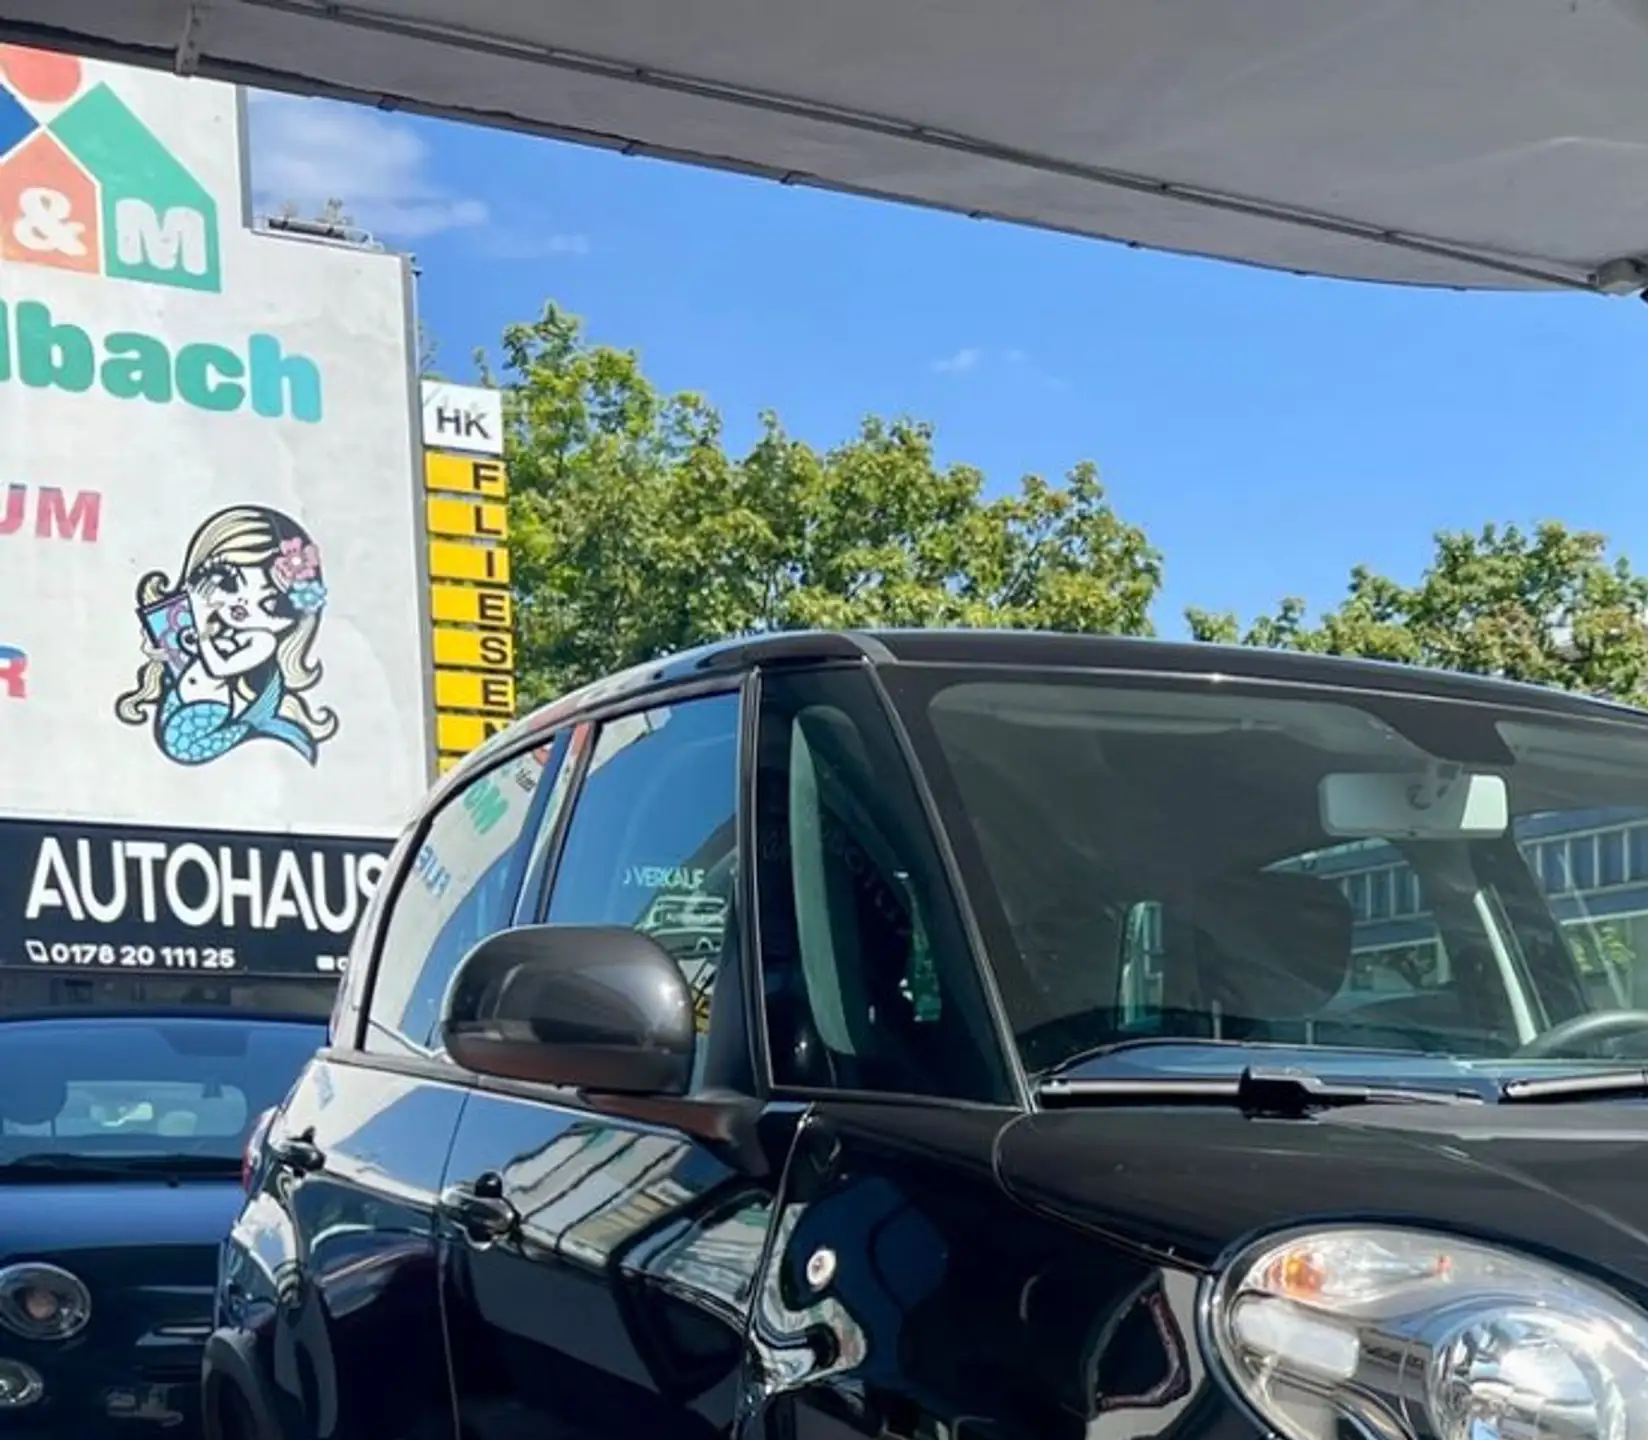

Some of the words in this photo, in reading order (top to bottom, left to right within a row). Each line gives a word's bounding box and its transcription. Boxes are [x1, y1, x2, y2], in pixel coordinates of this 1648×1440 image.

[13, 187, 87, 256] &
[115, 197, 207, 275] M
[0, 297, 322, 423] bach
[436, 406, 492, 440] HK
[120, 945, 155, 966] 20
[160, 947, 198, 967] 111
[201, 948, 236, 969] 25
